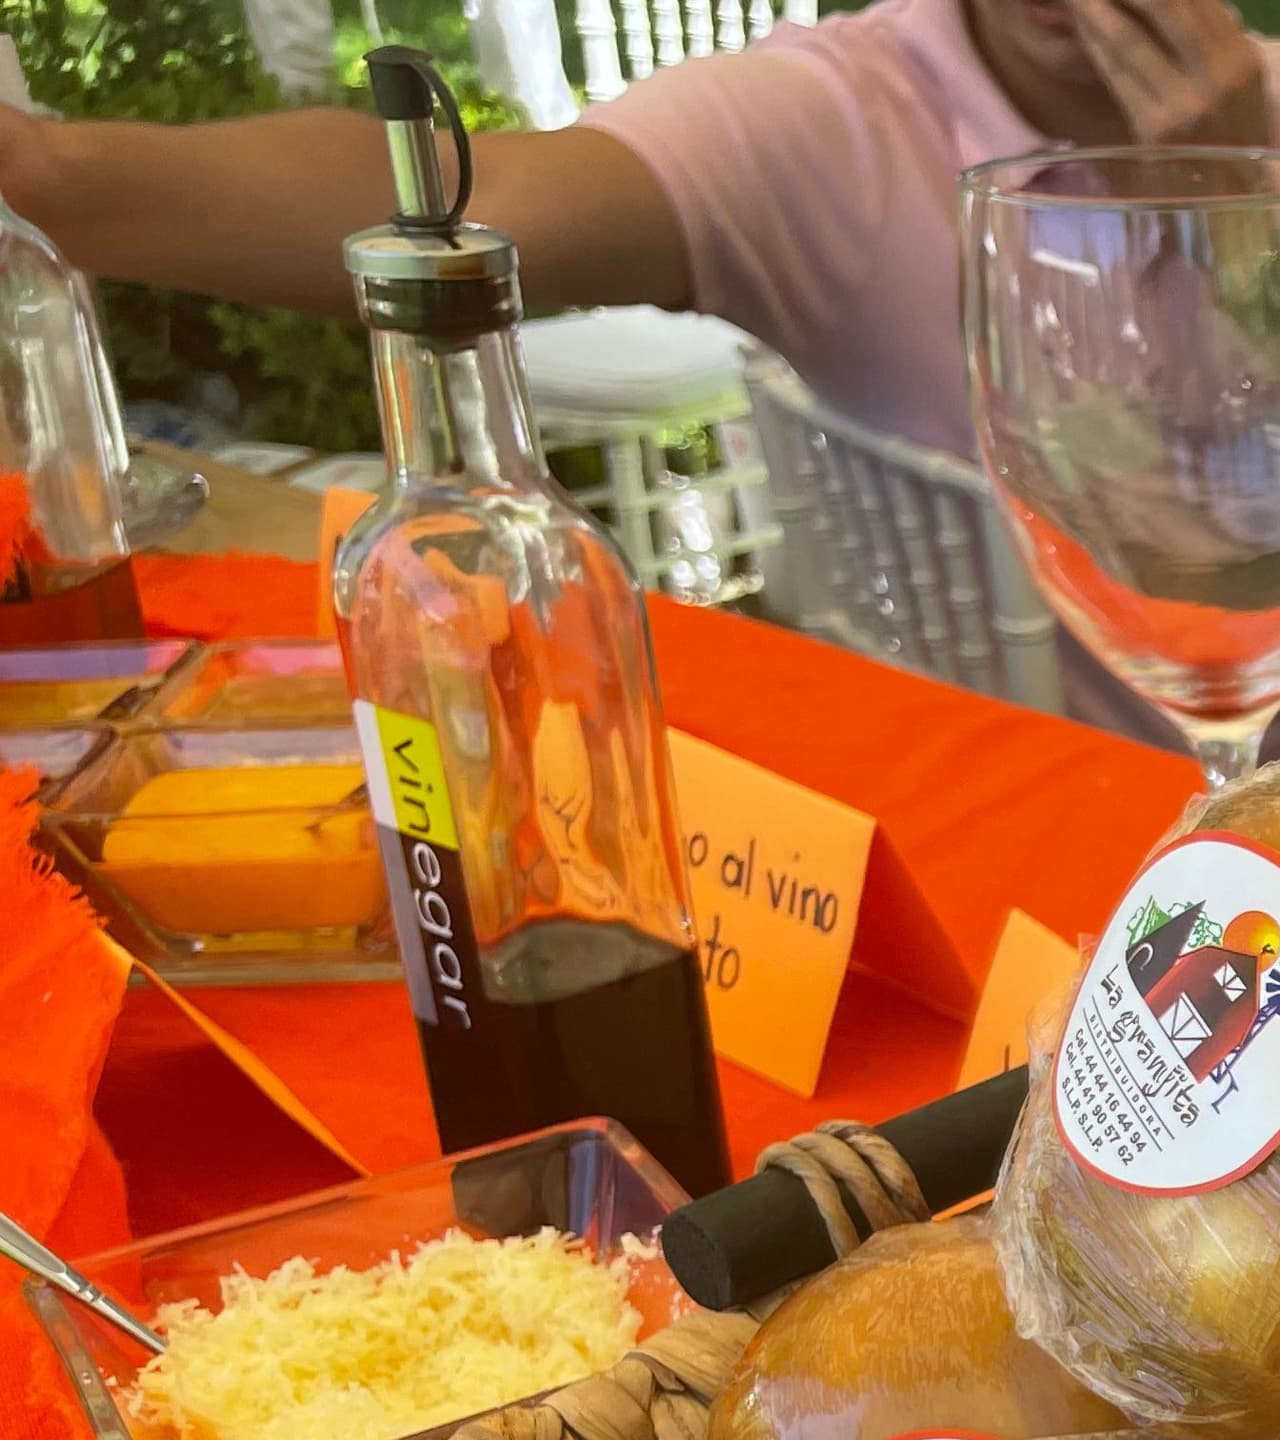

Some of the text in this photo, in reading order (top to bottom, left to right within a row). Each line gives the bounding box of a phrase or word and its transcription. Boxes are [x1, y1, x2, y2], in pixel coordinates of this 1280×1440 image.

[393, 739, 471, 1029] vinegar
[722, 838, 755, 896] al
[767, 853, 838, 933] vino
[1065, 1043, 1134, 1166] Cel. 44 41 90 57 62
[1075, 1028, 1147, 1153] Cel. 44 44 16 44 94
[1101, 963, 1199, 1128] La granjita
